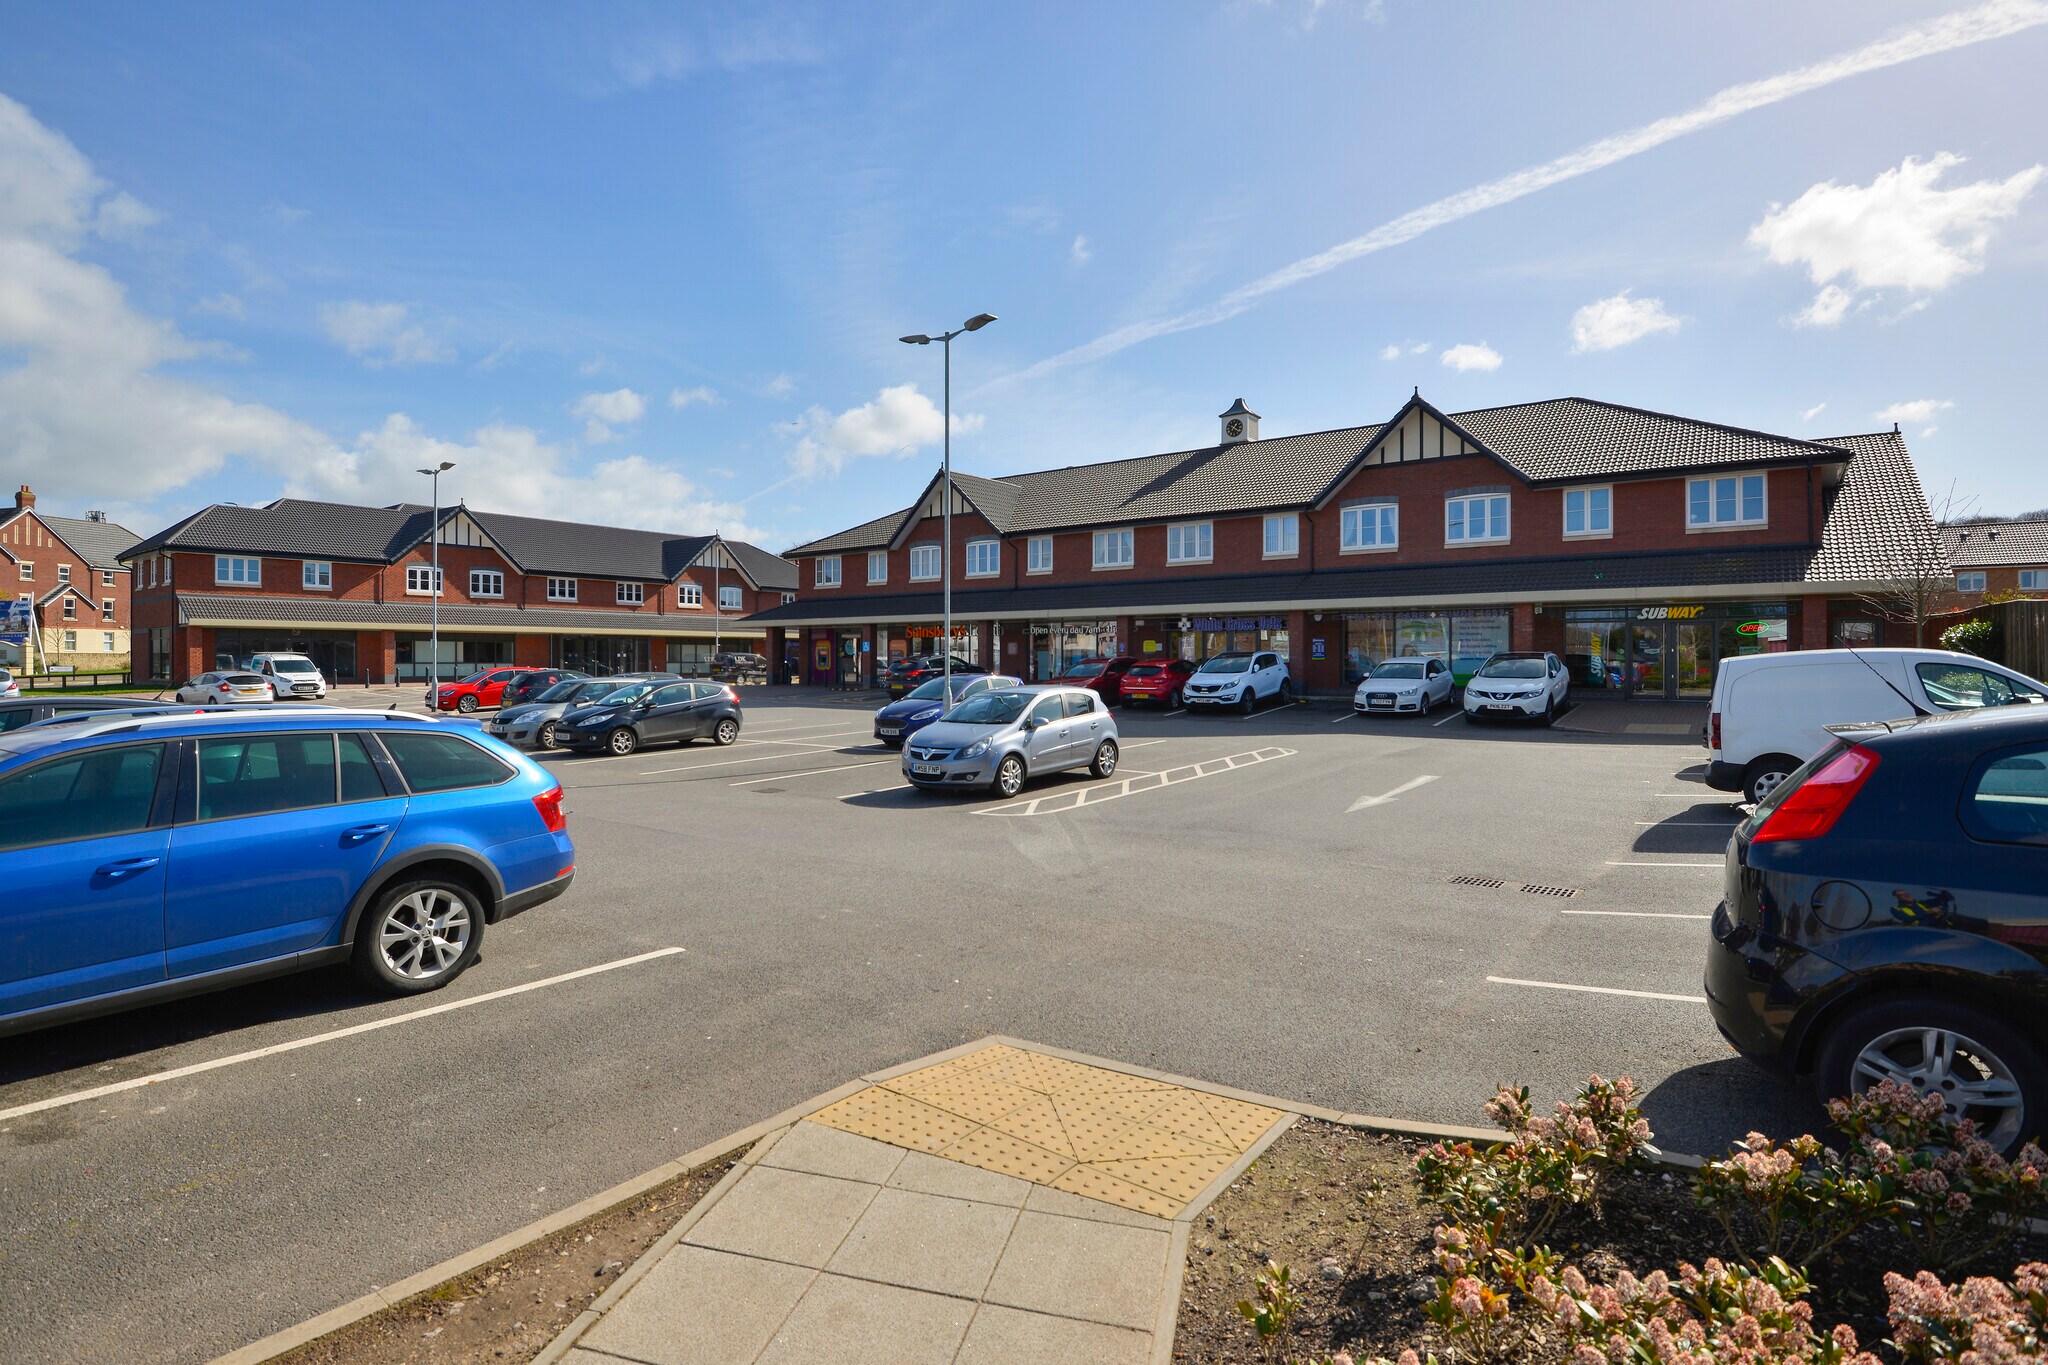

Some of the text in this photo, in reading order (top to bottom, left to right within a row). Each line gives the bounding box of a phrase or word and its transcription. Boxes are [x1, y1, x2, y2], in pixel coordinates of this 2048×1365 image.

[1637, 606, 1704, 620] SUBWAY
[1030, 626, 1048, 636] Open
[1049, 627, 1068, 635] every
[1070, 625, 1084, 635] day
[1193, 616, 1282, 631] White Cross Vets
[1740, 624, 1766, 633] OPEN
[906, 625, 967, 640] Sainsbuy's
[1590, 632, 1602, 677] SUBWAY
[928, 765, 940, 774] FNP
